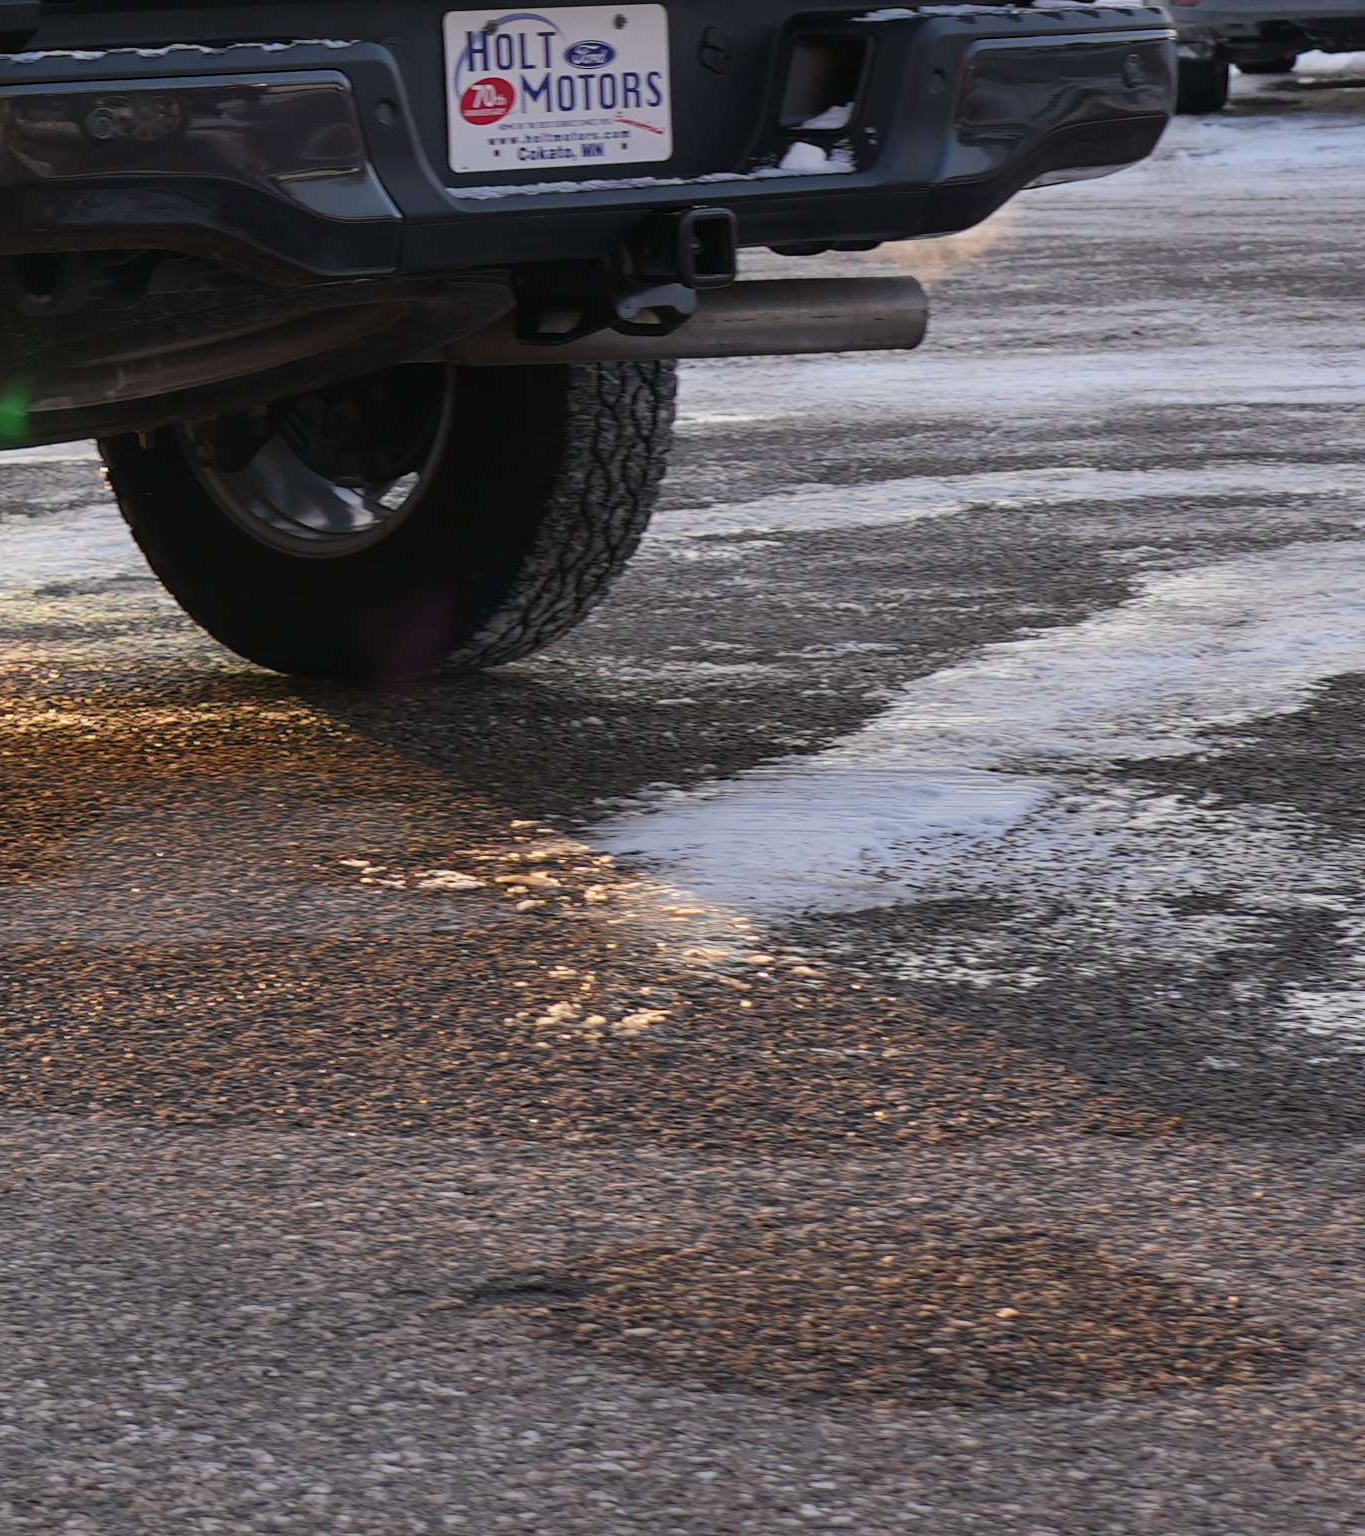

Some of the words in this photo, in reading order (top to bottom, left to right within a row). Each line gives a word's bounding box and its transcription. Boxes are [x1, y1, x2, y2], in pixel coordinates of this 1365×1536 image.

[466, 30, 557, 72] HOLT
[570, 44, 609, 65] Ford
[522, 71, 663, 113] MOTORS
